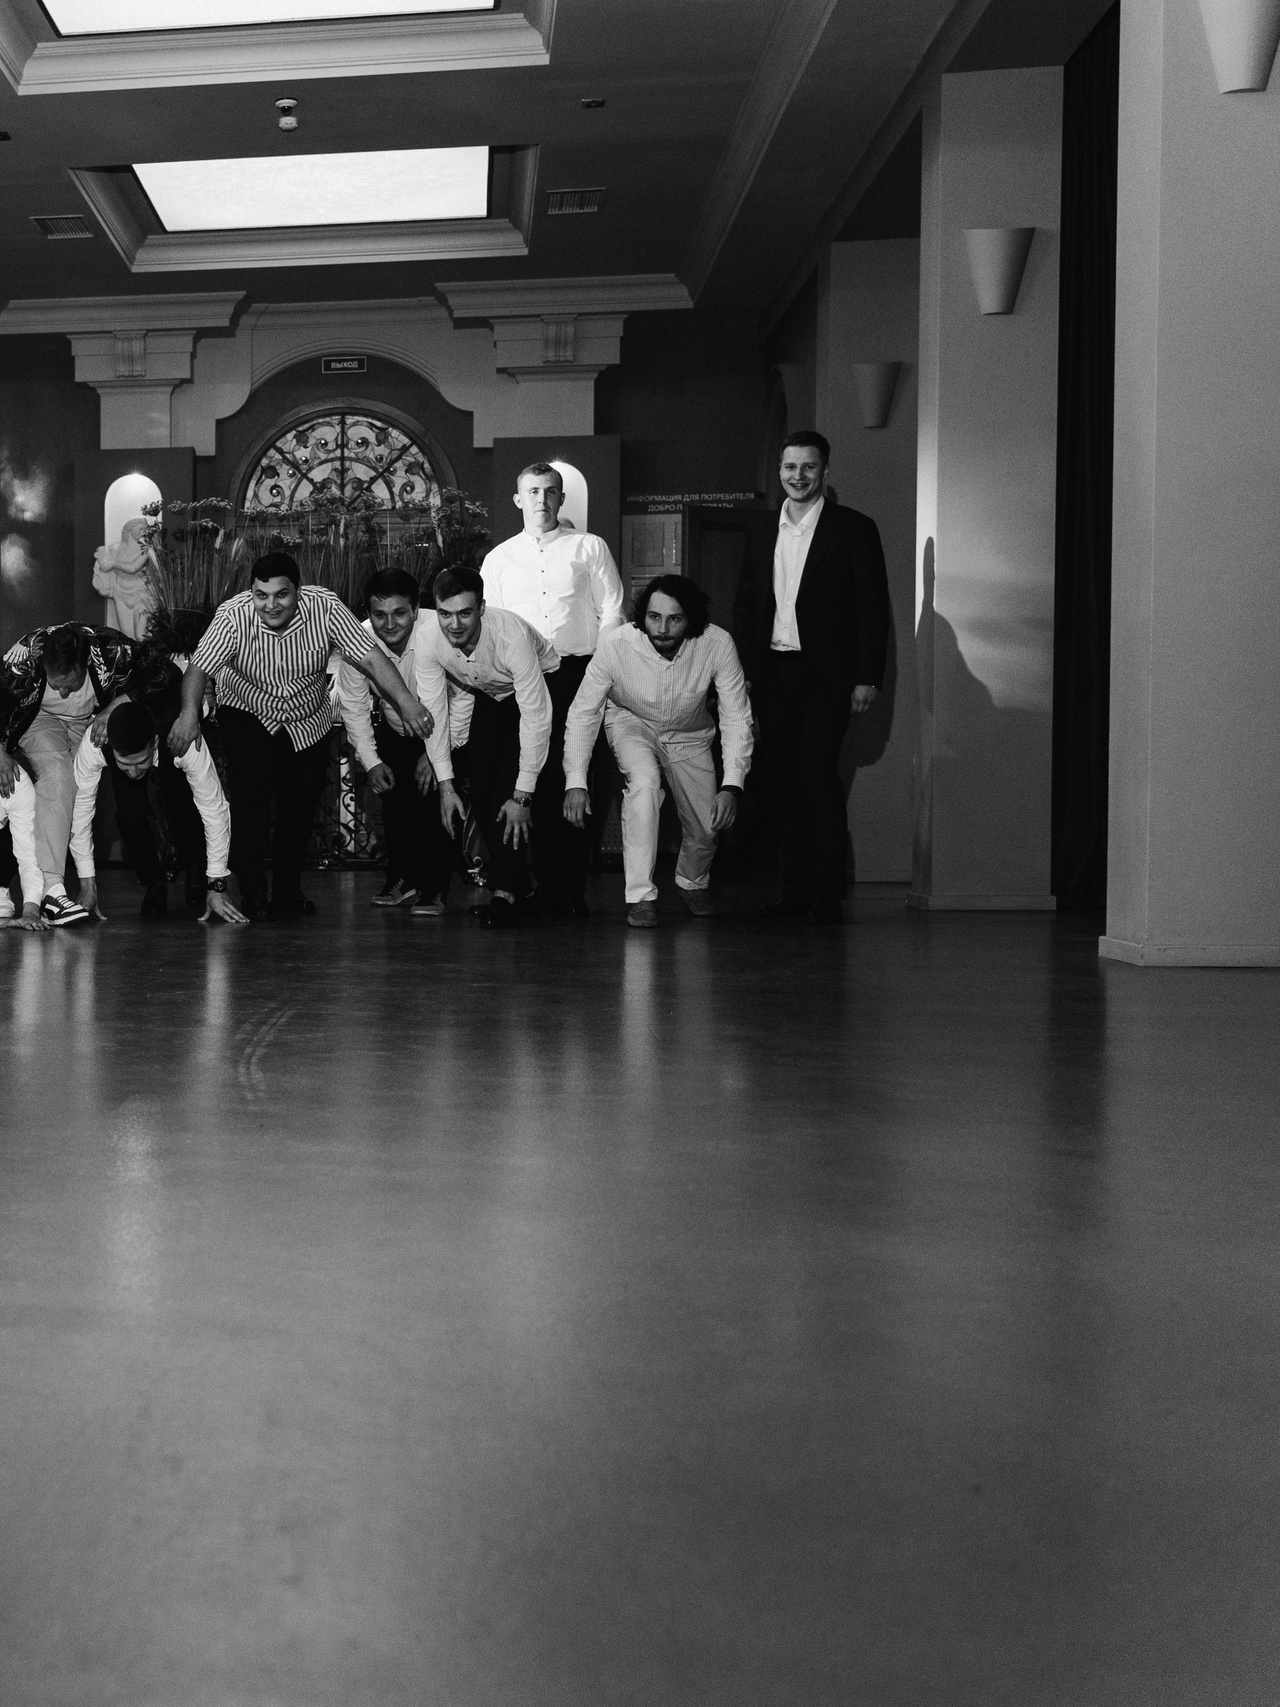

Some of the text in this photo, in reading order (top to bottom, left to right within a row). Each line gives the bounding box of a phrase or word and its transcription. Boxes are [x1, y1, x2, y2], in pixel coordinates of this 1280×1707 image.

[331, 361, 358, 369] ВЫХОД
[626, 492, 755, 502] ИНФОРМАЦИЯ ДЛЯ ПОТРЕБИТЕЛЯ
[647, 504, 676, 512] ДОБРО
